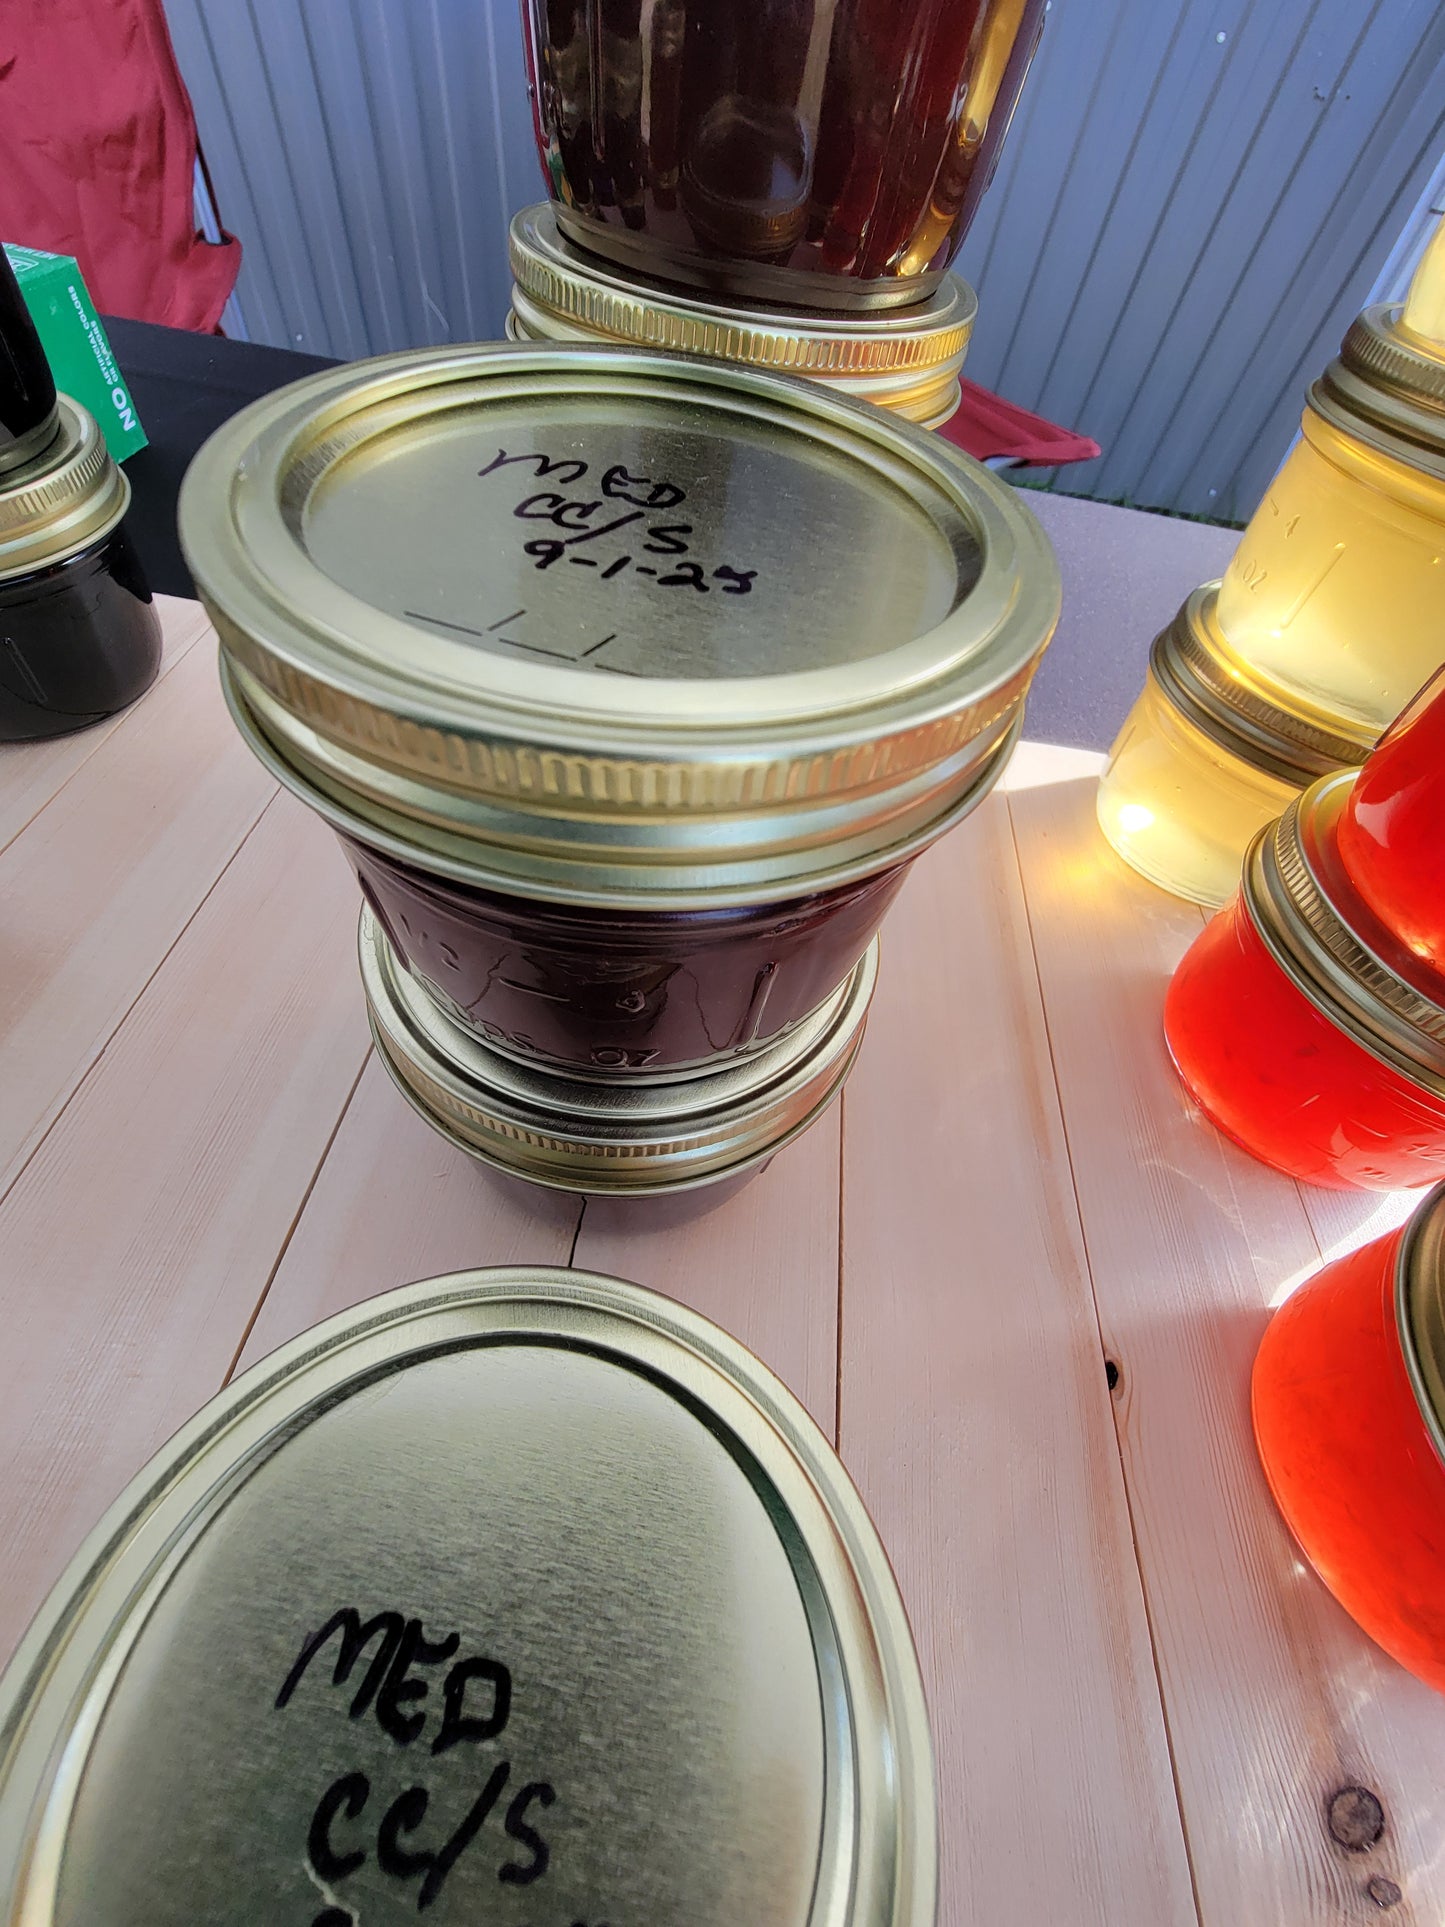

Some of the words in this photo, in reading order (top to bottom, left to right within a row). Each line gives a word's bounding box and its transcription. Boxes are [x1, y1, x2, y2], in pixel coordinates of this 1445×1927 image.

[67, 285, 90, 330] COLORS
[88, 331, 113, 385] ARTIFICIAL
[90, 320, 112, 366] FLAVORS
[109, 366, 119, 382] OR
[111, 387, 137, 431] NO
[477, 448, 687, 509] MED
[274, 1607, 512, 1756] MED
[307, 1761, 556, 1912] CC/S
